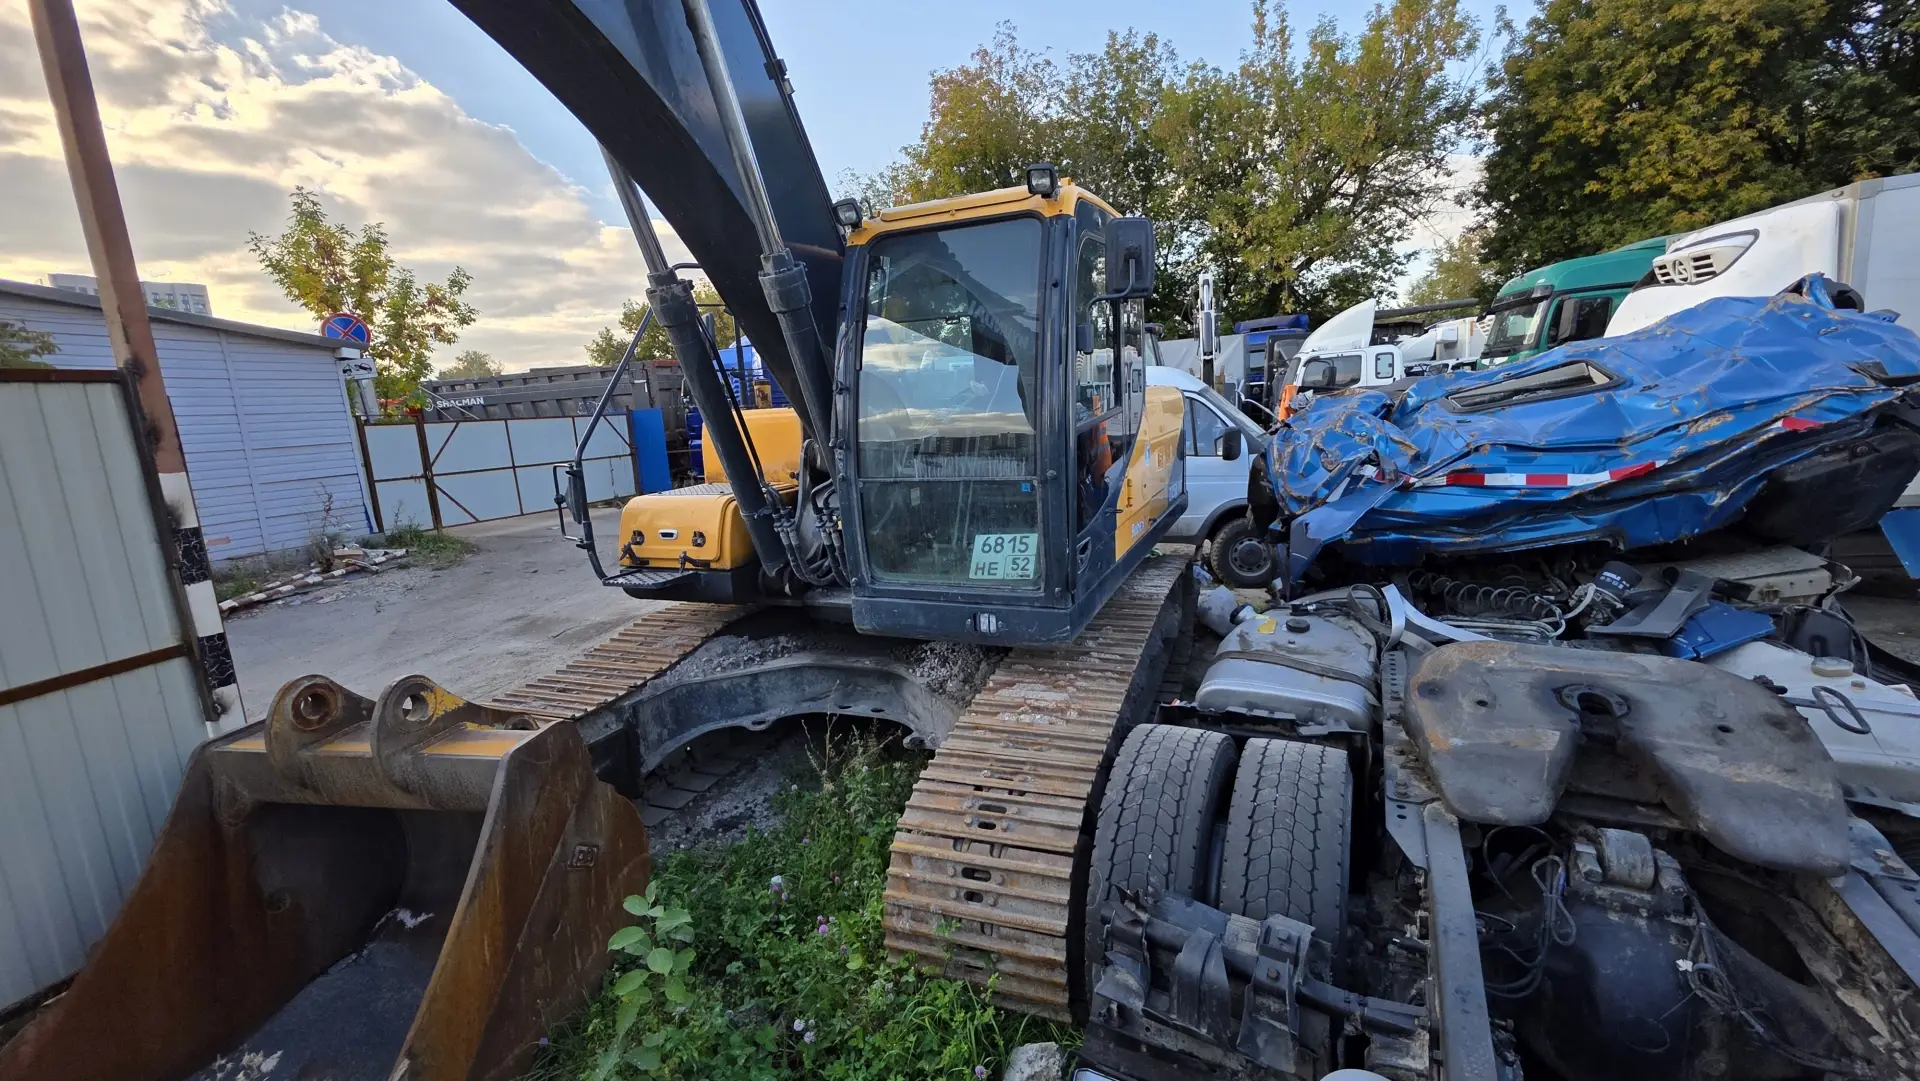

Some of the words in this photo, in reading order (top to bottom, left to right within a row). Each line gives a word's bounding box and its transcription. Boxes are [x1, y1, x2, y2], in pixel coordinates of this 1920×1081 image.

[436, 396, 485, 408] SHACMAN
[980, 535, 1030, 554] 6815
[1010, 557, 1030, 572] 52
